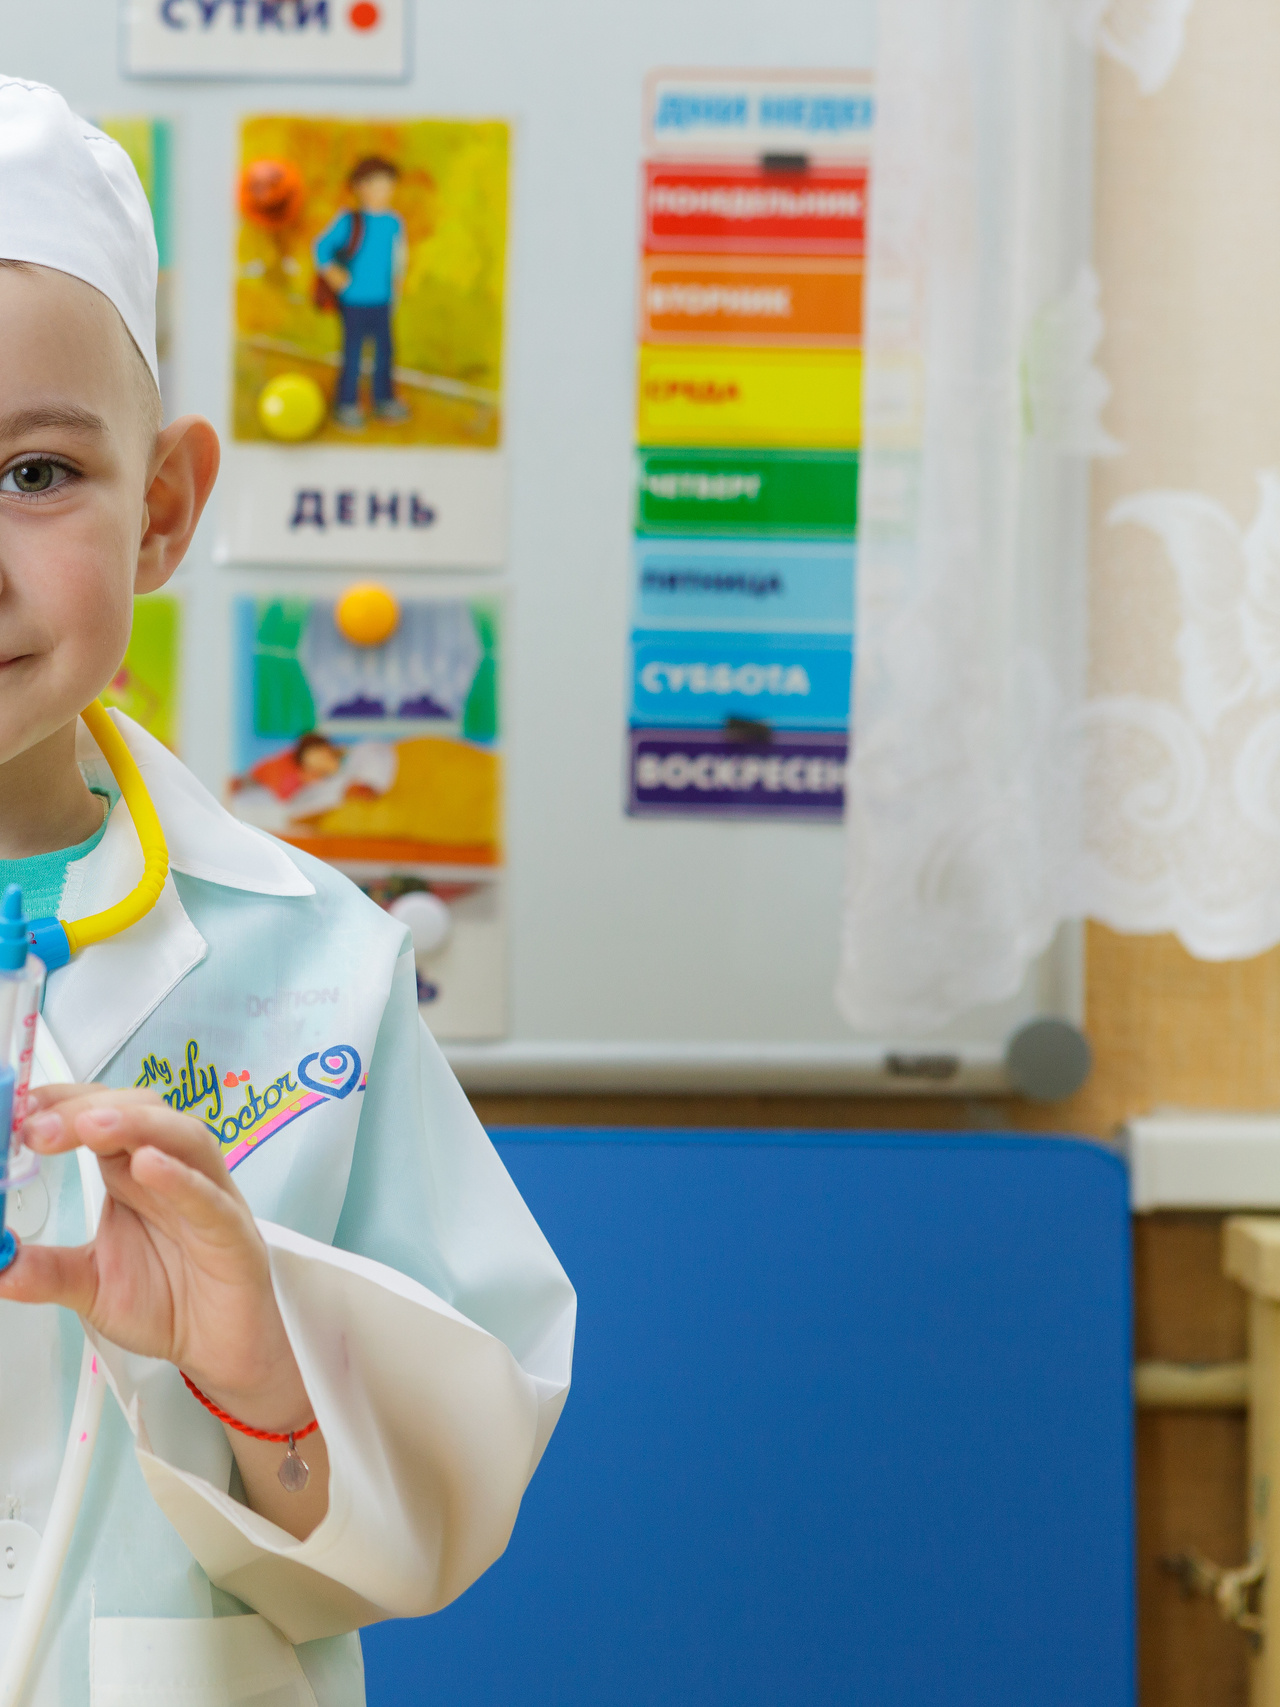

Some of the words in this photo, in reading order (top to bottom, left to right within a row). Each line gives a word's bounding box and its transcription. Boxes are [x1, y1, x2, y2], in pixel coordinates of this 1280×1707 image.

[158, 0, 332, 34] СУТКИ
[654, 95, 747, 131] ДНИ
[648, 284, 792, 317] ВТОРНИК
[645, 381, 741, 407] СРЕДА
[643, 472, 762, 502] ЧЕТВЕРГ
[289, 488, 438, 531] ДЕНЬ
[641, 566, 785, 601] ПЯТНИЦА
[639, 661, 812, 696] СУББОТА
[135, 1054, 172, 1089] My
[198, 1072, 298, 1148] octor
